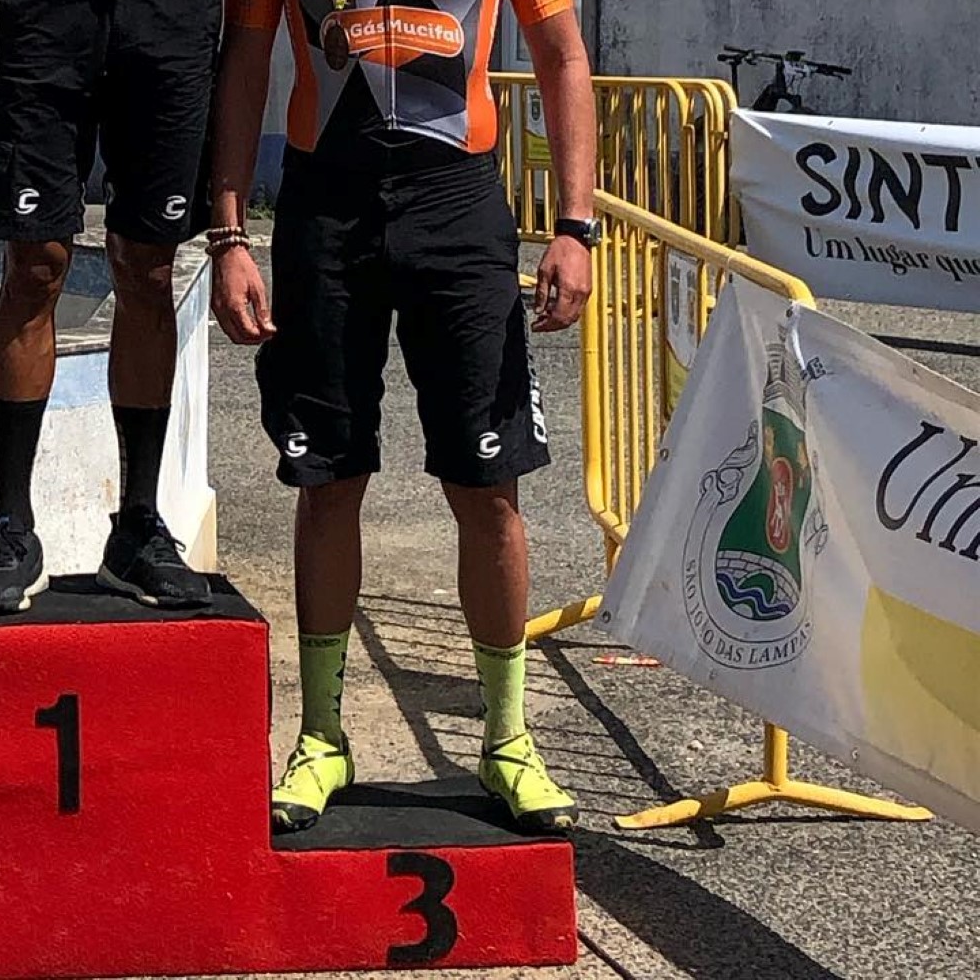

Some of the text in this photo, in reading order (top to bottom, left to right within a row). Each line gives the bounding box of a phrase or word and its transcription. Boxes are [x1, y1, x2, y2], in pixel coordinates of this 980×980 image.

[795, 142, 980, 233] SINT
[803, 226, 856, 261] Um
[854, 236, 929, 276] lugar
[747, 622, 812, 665] LAMPA
[35, 693, 81, 816] 1
[384, 853, 458, 966] 3
